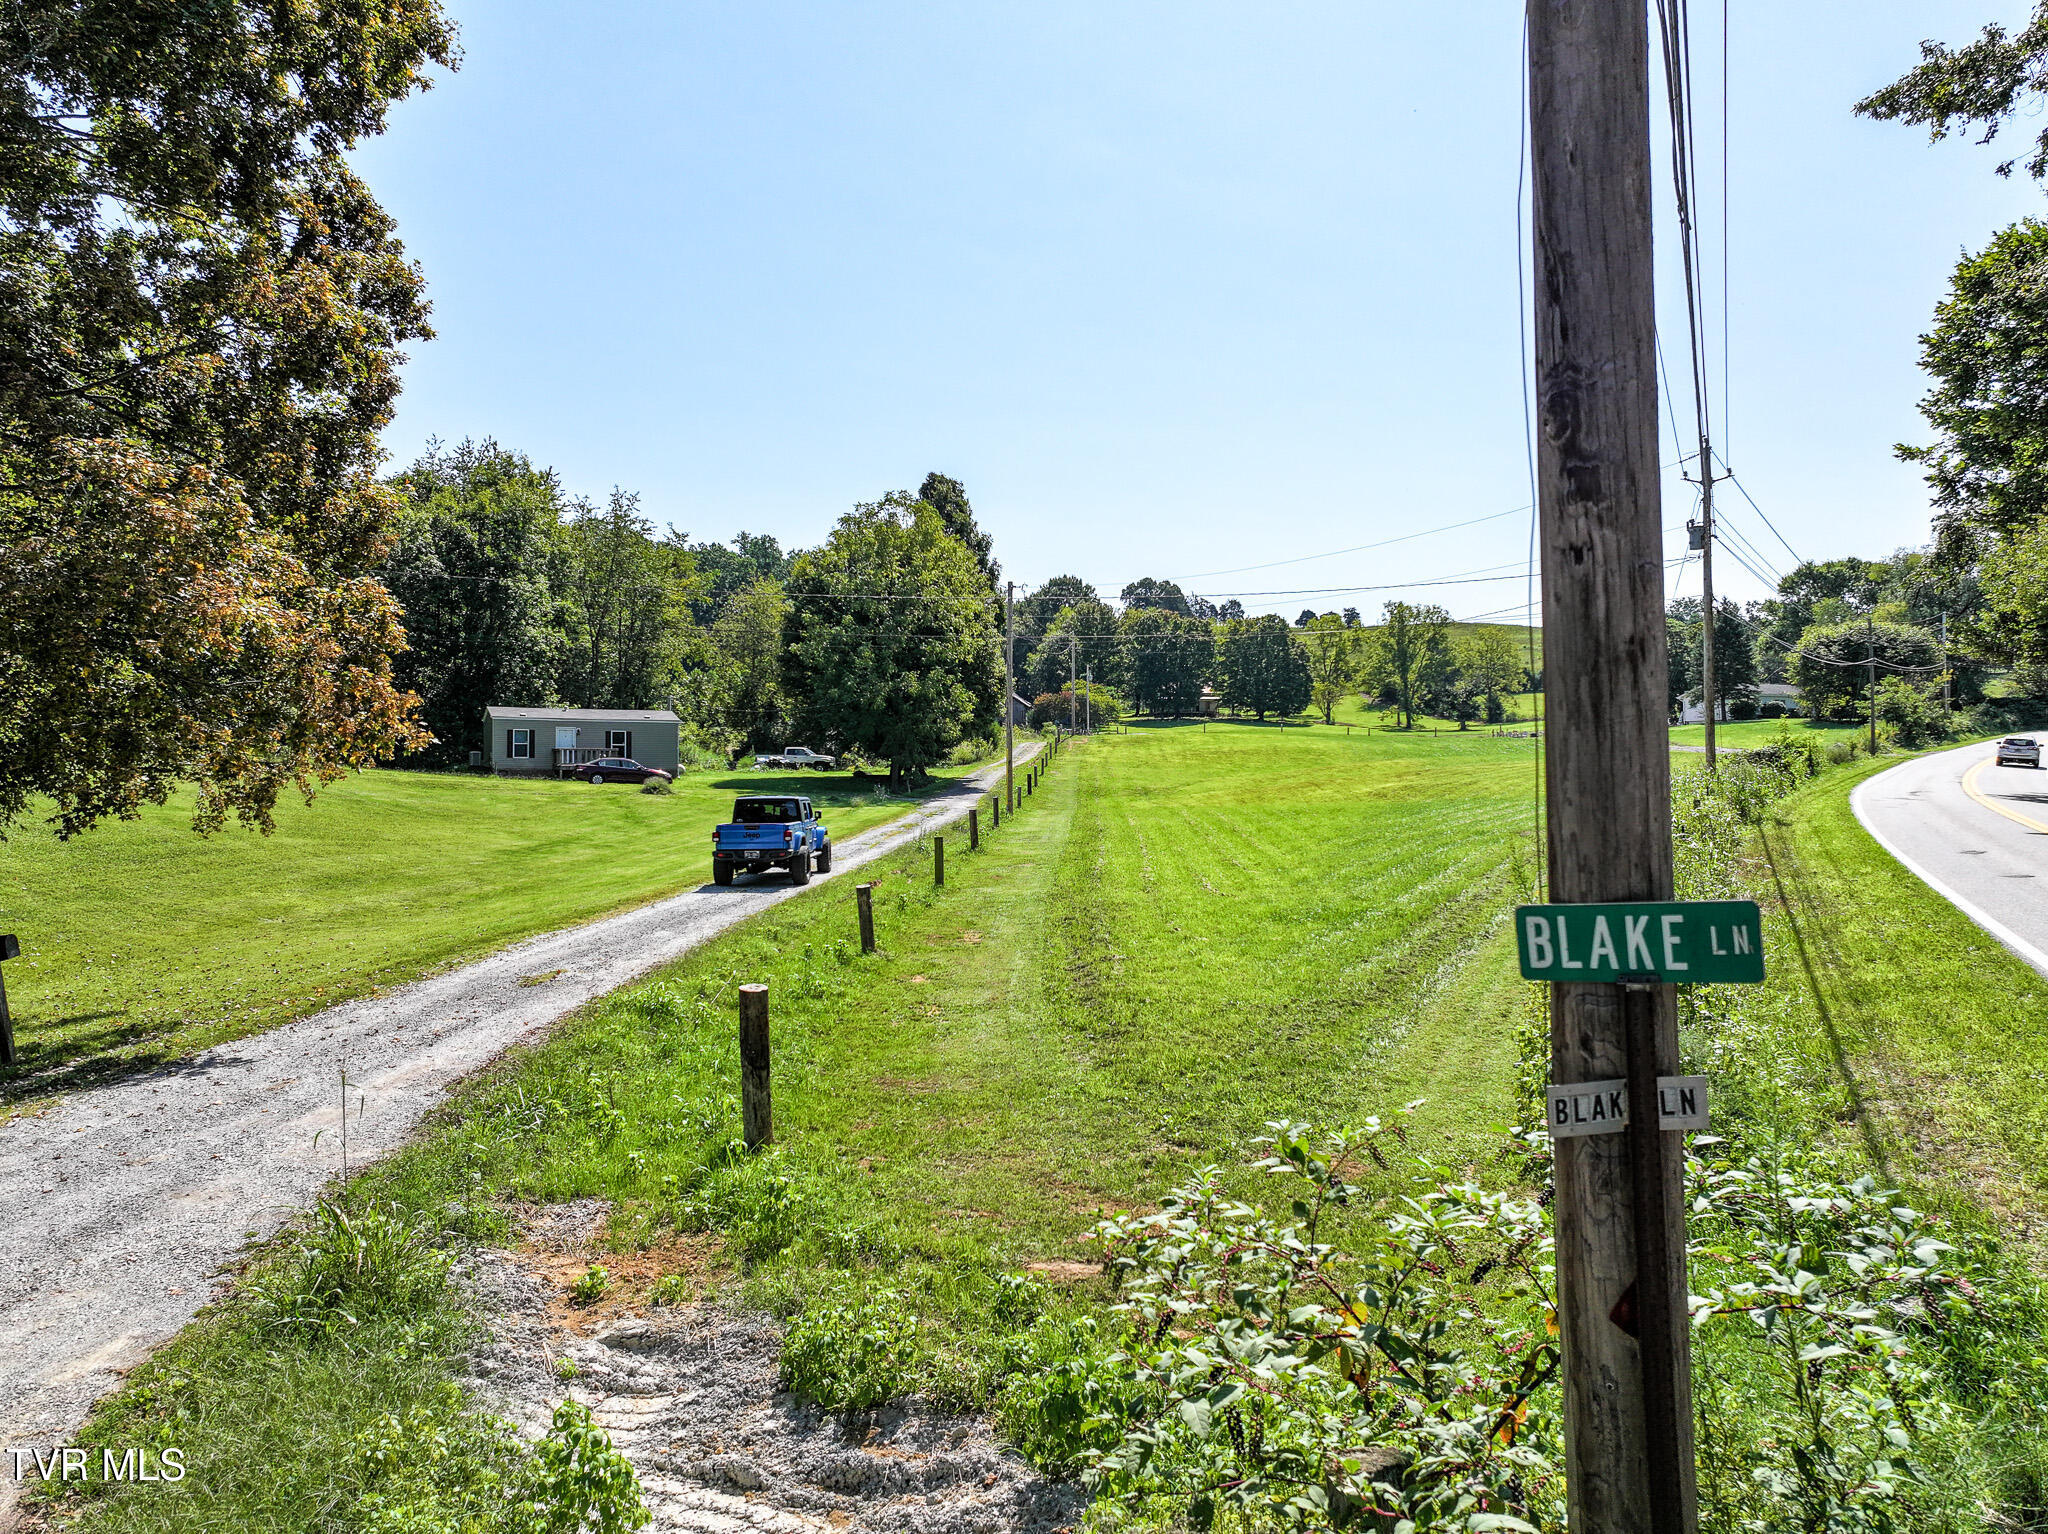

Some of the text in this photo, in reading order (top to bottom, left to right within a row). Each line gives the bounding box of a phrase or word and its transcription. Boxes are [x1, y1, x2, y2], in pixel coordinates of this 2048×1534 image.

[743, 831, 760, 840] Jeep
[1525, 914, 1689, 971] BLAKE
[1554, 1088, 1697, 1125] BLAK LN
